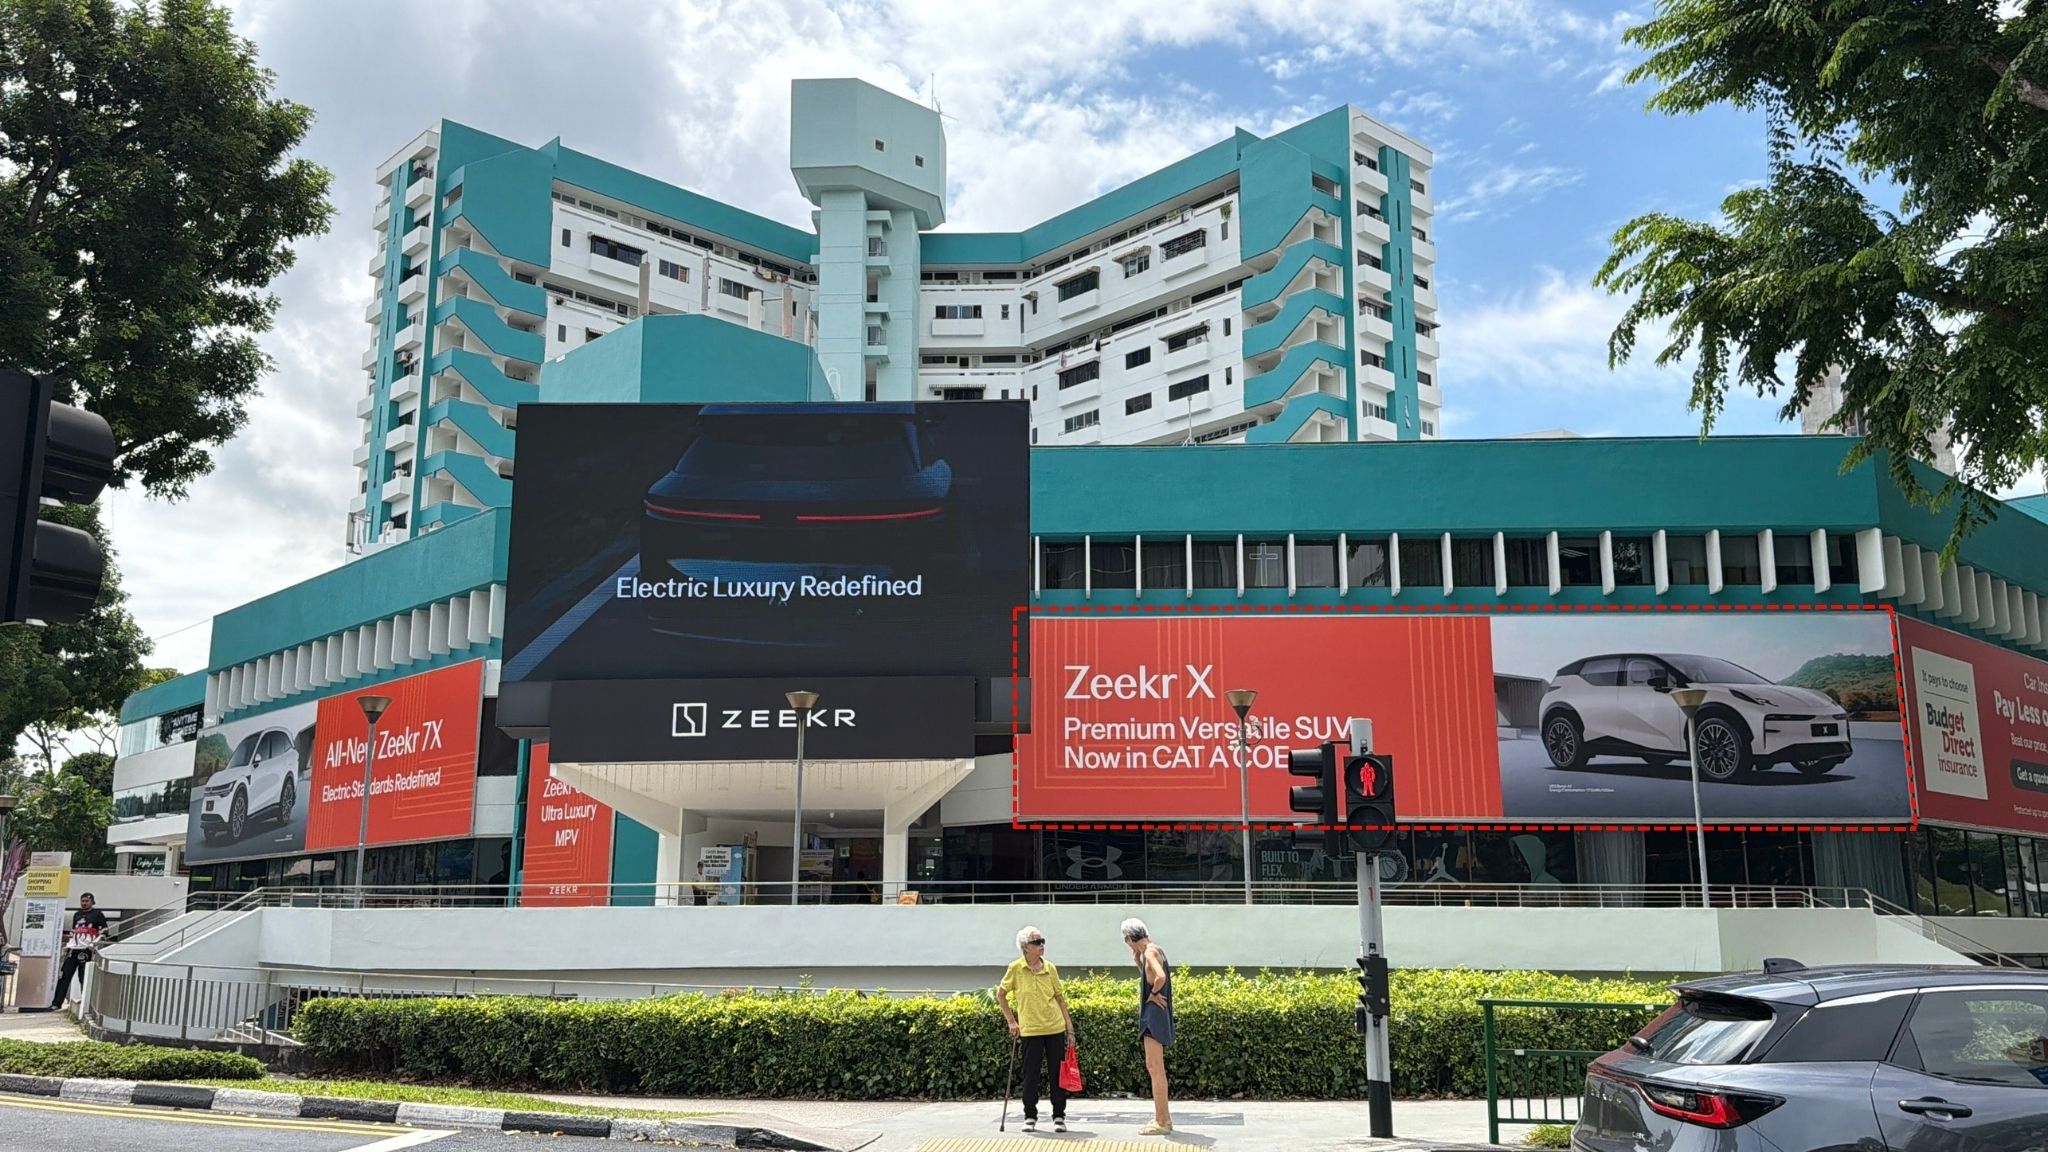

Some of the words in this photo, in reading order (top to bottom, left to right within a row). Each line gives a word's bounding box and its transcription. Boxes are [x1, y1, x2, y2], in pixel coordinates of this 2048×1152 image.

[617, 577, 708, 598] Electric
[714, 576, 796, 602] Luxury
[801, 575, 922, 597] Redefined
[1064, 664, 1178, 700] Zeekr
[1185, 664, 1216, 699] X
[1928, 674, 1941, 688] pays
[1942, 675, 1949, 688] to
[1949, 678, 1969, 693] choose
[2023, 672, 2037, 690] Car
[721, 709, 856, 729] ZEEKR
[1925, 702, 1966, 736] Budget
[1993, 689, 2015, 725] Pay
[2016, 696, 2041, 726] Less
[378, 726, 420, 760] Zeekr
[422, 719, 444, 752] 7X
[1064, 717, 1176, 740] Premium
[1295, 716, 1352, 740] SUV
[1941, 730, 1976, 759] Direct
[1064, 746, 1121, 769] Now
[1126, 746, 1147, 769] in
[1152, 745, 1206, 769] CAT
[1209, 745, 1229, 769] A
[1232, 745, 1290, 769] COE
[1937, 753, 1978, 778] insurance
[322, 781, 351, 803] Electric
[352, 775, 394, 798] Stadards
[395, 767, 441, 792] Redefined
[2016, 766, 2028, 781] Get
[541, 805, 563, 822] Ultra
[564, 803, 597, 821] Luxury
[555, 828, 580, 847] MPV
[1261, 850, 1285, 863] BUILT
[1287, 850, 1299, 863] TO
[1262, 864, 1286, 877] FLEX.
[549, 885, 578, 895] ZEEKR
